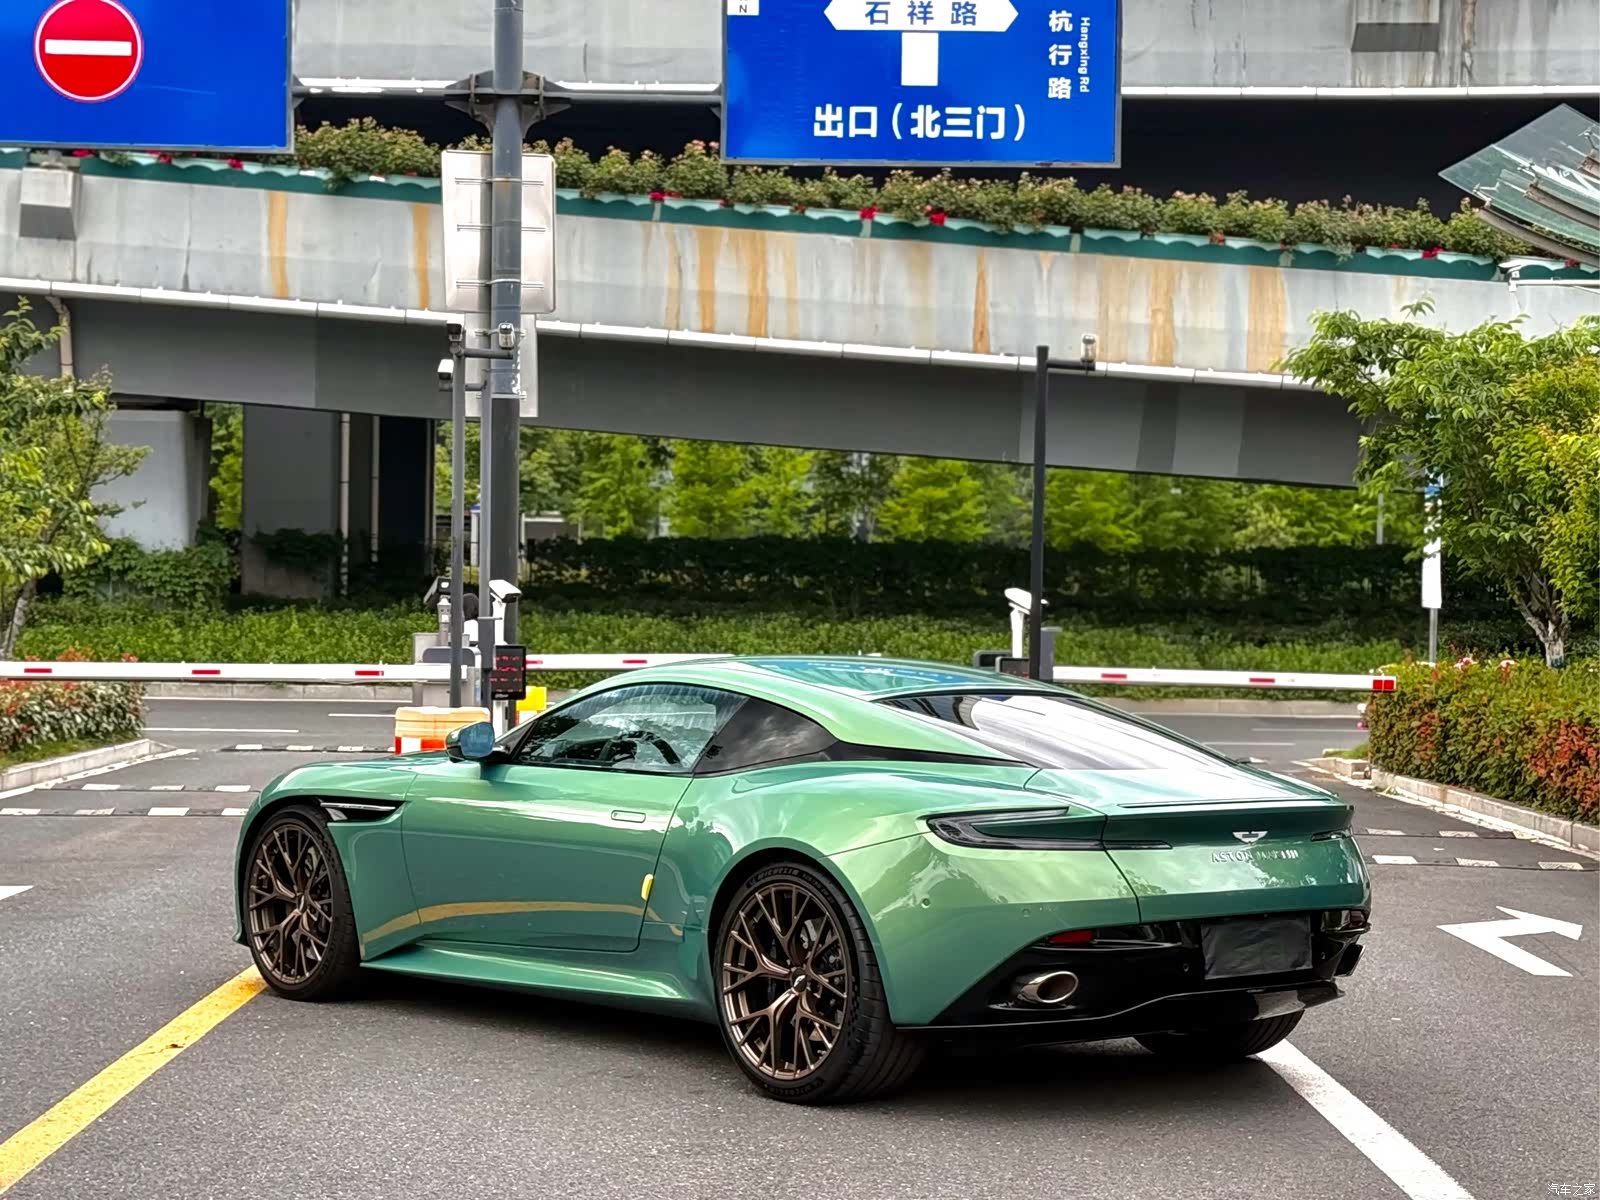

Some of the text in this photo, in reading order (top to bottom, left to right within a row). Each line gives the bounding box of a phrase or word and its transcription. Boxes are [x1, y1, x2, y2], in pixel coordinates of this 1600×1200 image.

[738, 4, 748, 13] N
[864, 0, 977, 26] 石祥路
[1047, 9, 1073, 99] 杭行路
[1077, 17, 1090, 92] Hangxing Rd
[813, 102, 1026, 141] 出口（北三门）
[1211, 850, 1253, 862] ASTON
